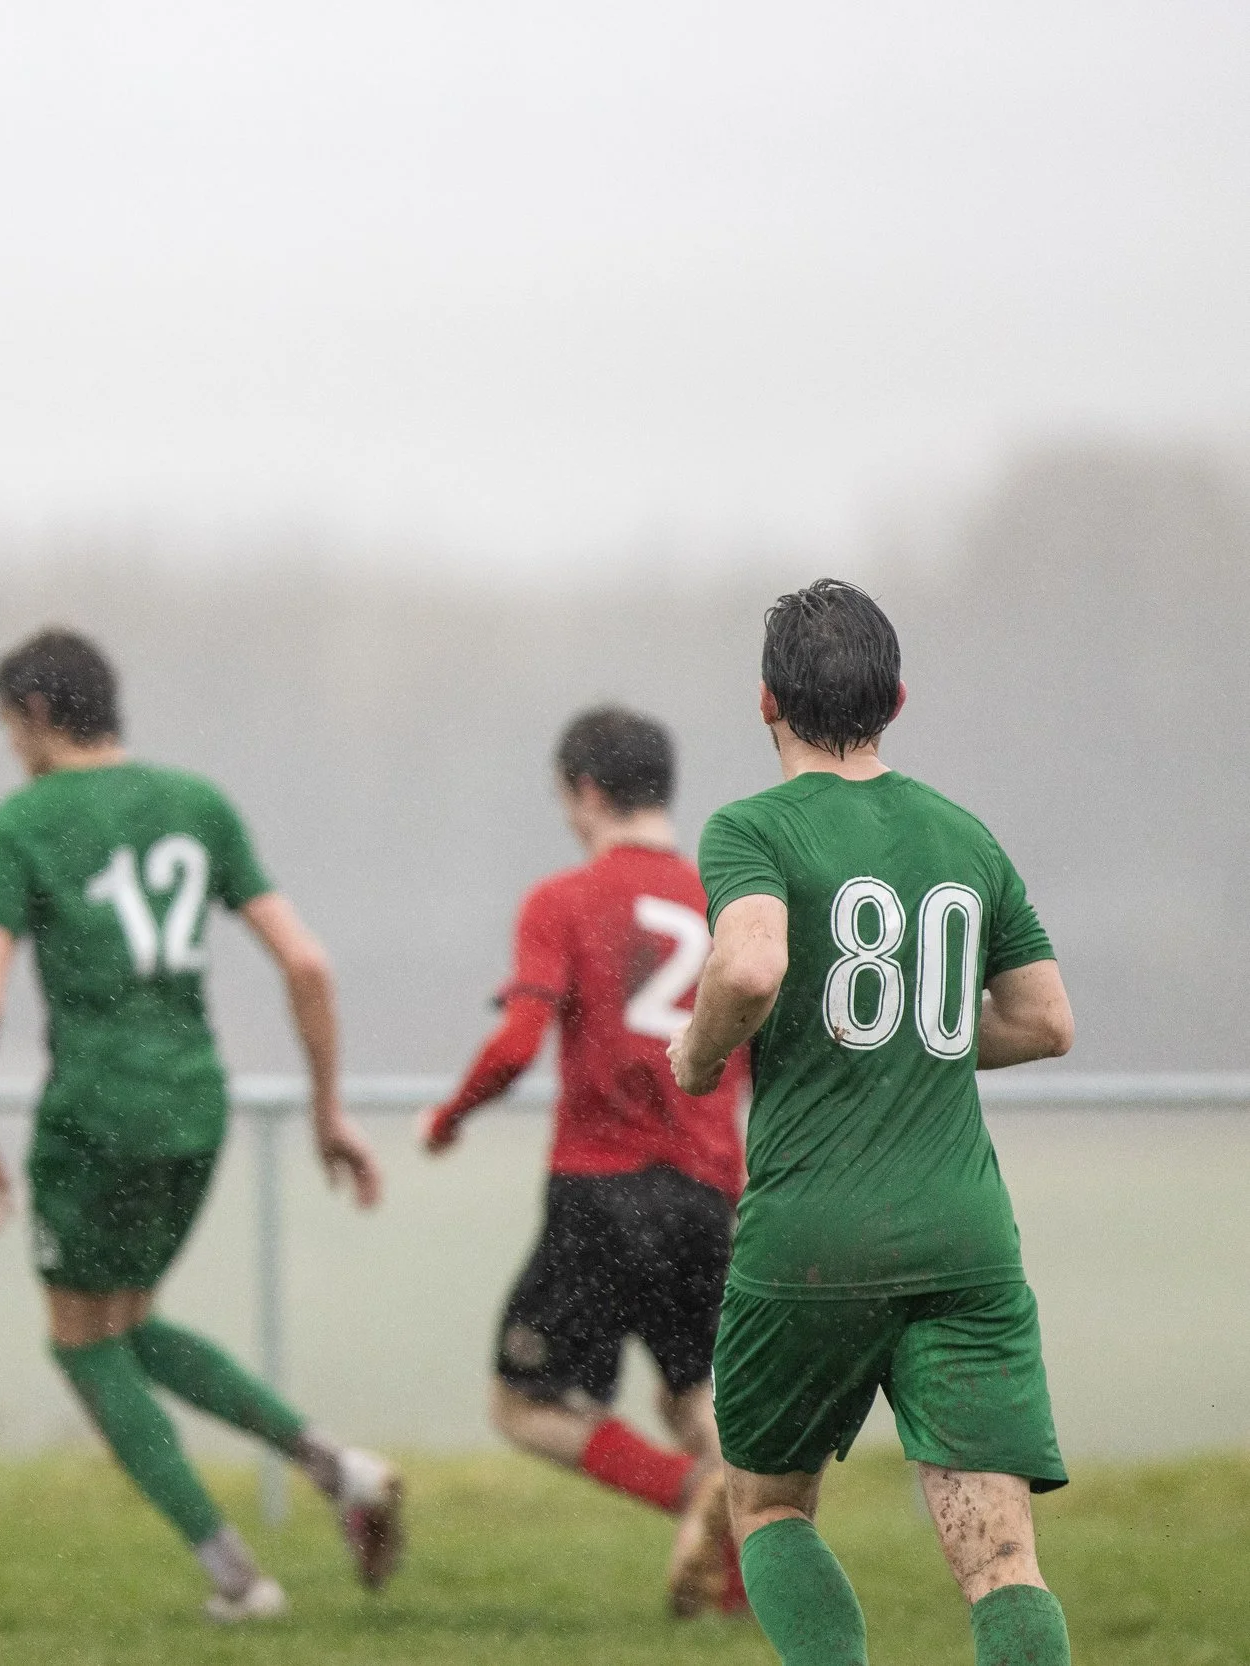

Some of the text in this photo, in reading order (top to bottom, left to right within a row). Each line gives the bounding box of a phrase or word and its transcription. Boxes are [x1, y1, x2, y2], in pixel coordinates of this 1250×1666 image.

[84, 833, 207, 974] 12
[624, 895, 712, 1038] 2
[823, 876, 983, 1059] 80
